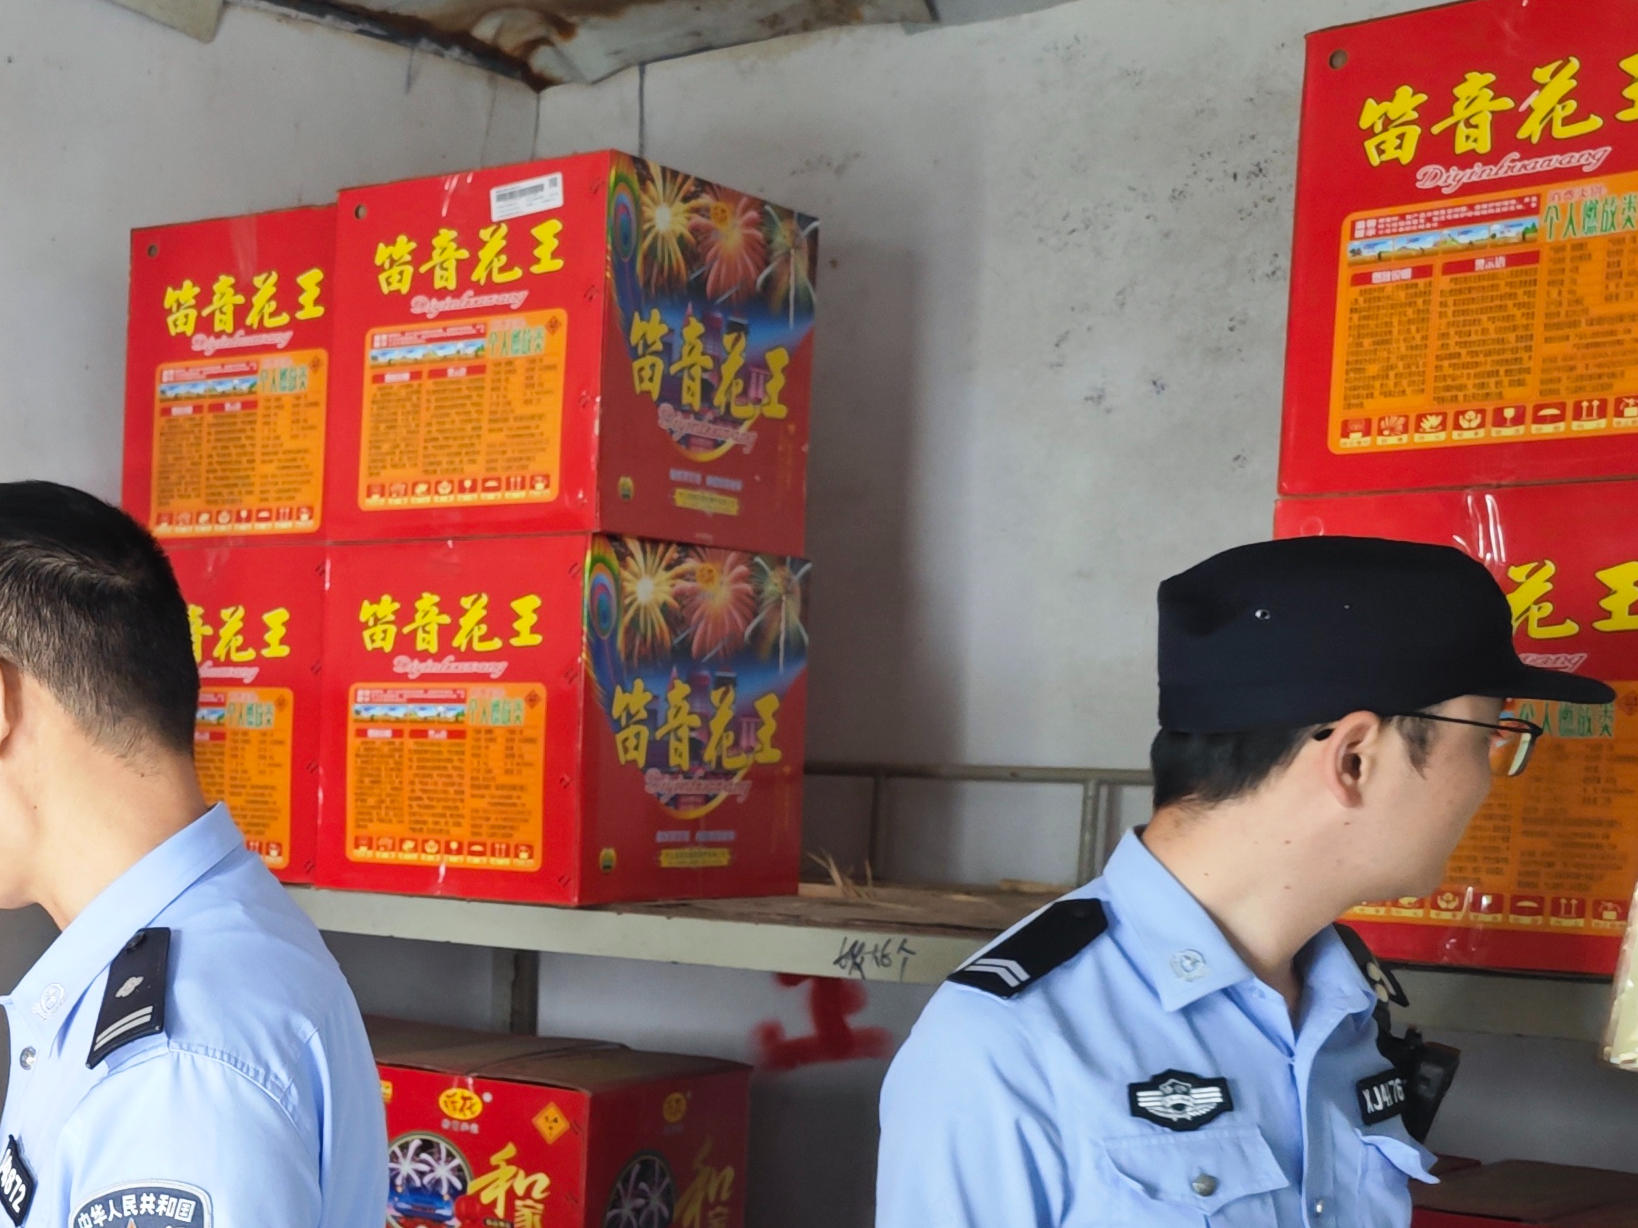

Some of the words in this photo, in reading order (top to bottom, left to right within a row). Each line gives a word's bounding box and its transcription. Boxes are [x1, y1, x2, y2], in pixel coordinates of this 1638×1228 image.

[1415, 145, 1613, 194] Diyinhuawang
[373, 218, 565, 295] 笛音花王
[162, 268, 327, 338] 笛音花王
[627, 309, 788, 420] 笛音花王
[359, 592, 544, 655] 笛音花王
[610, 678, 784, 772] 笛音花王
